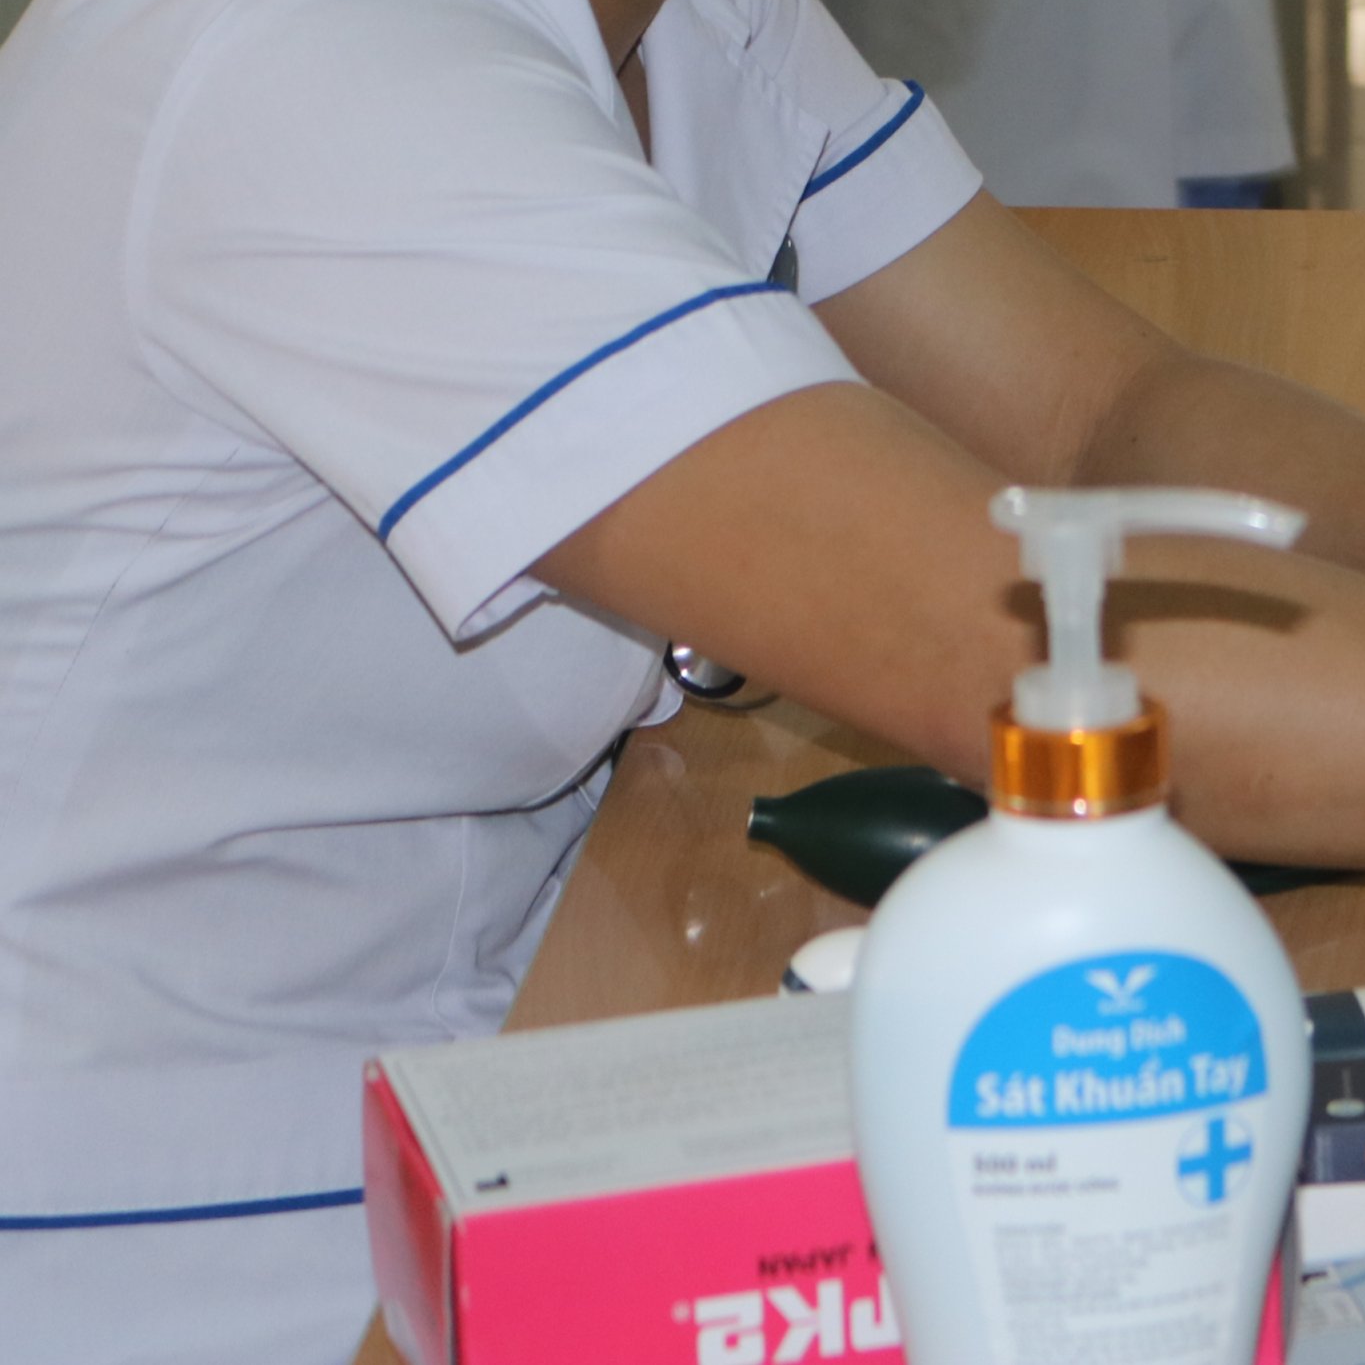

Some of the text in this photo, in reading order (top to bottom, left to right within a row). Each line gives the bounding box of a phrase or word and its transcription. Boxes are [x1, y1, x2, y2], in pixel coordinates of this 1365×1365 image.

[1052, 1022, 1126, 1059] Dung
[976, 1069, 1045, 1119] Sát
[1190, 1052, 1251, 1097] Tay
